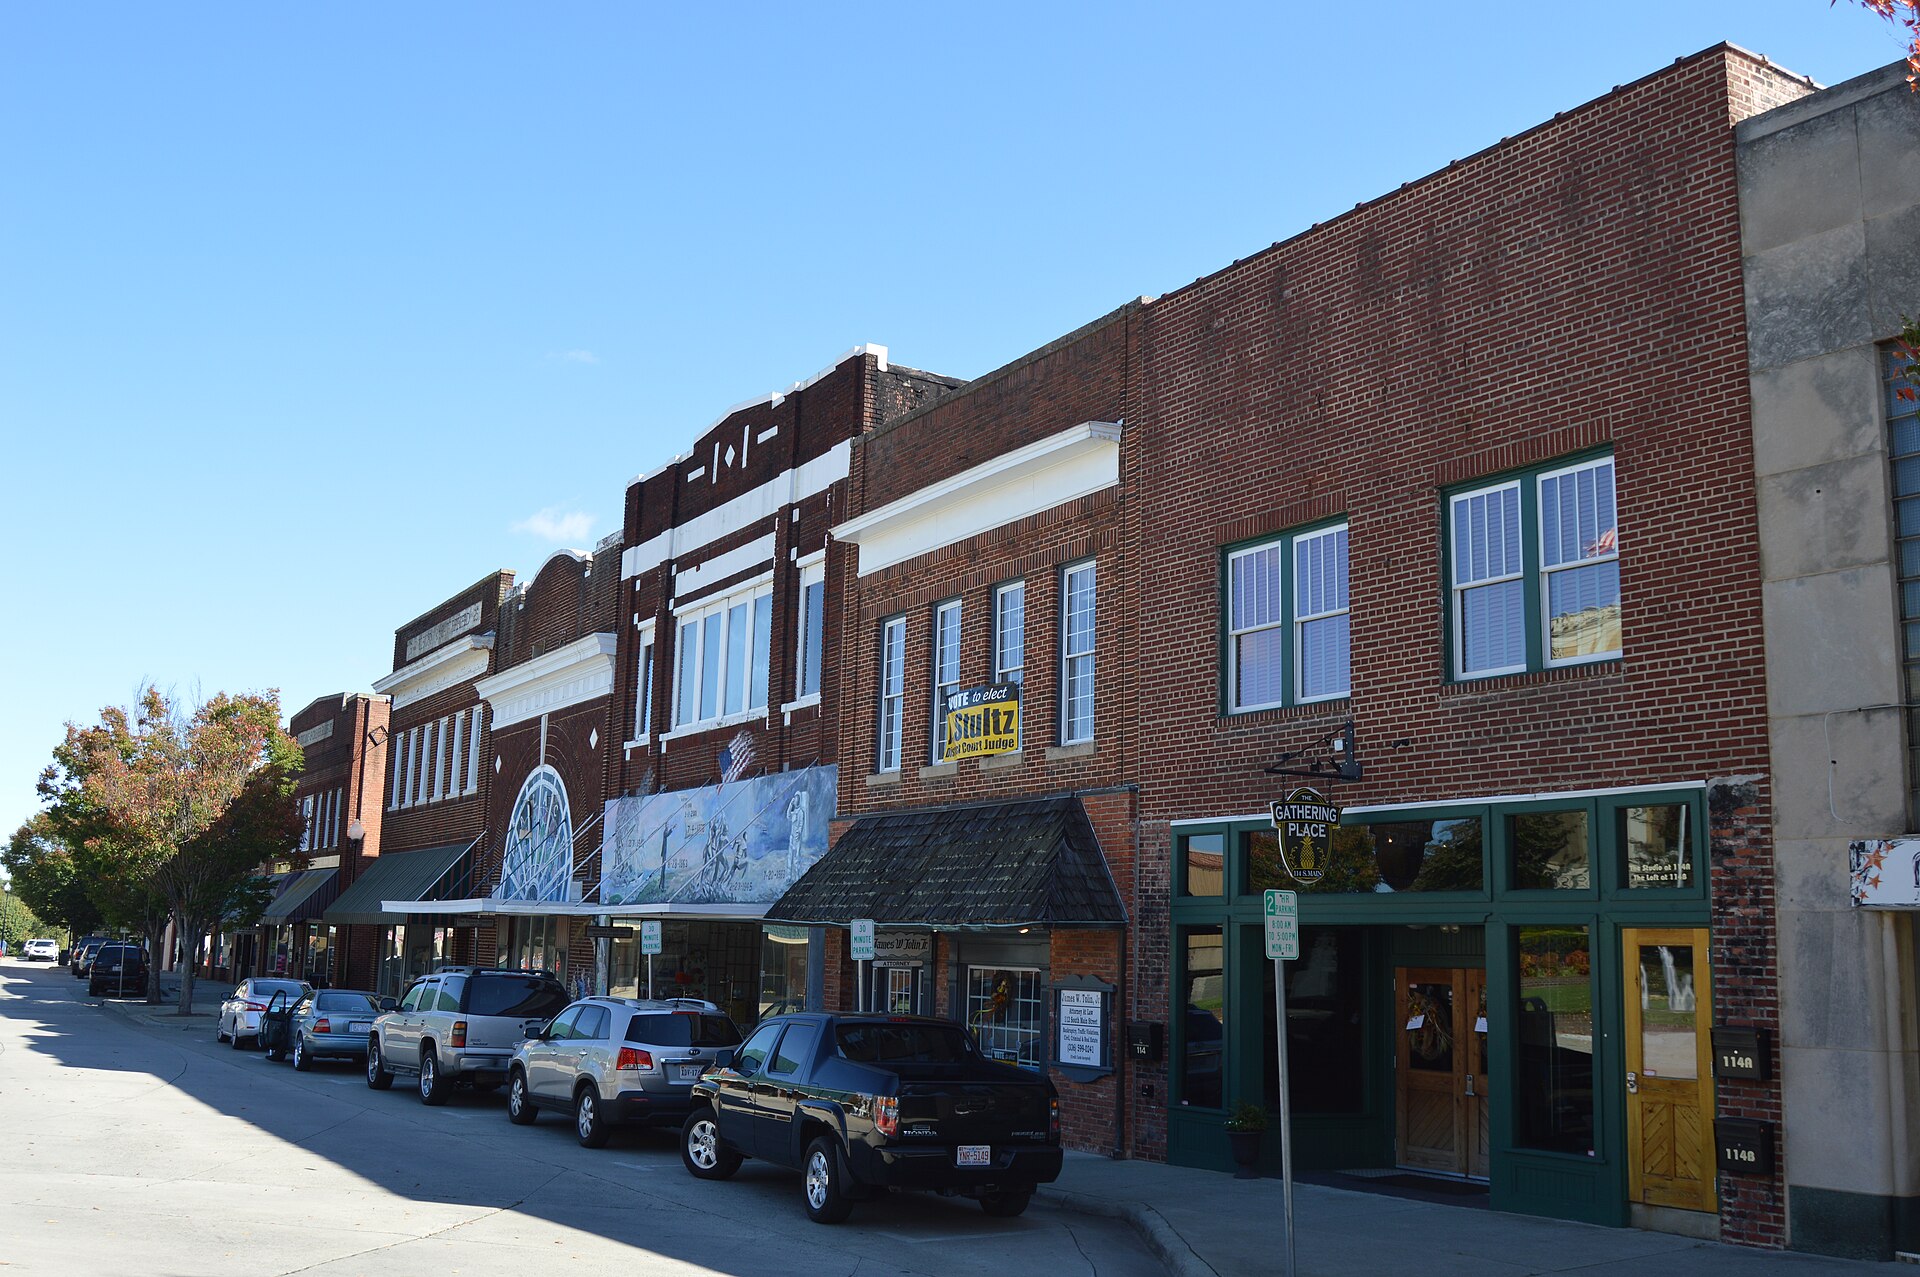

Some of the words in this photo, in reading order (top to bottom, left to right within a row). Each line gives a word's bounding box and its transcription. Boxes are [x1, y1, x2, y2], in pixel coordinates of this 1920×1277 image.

[948, 692, 969, 709] VOTE
[972, 691, 981, 702] to
[983, 687, 1007, 700] elect
[955, 708, 1014, 741] Stultz
[962, 742, 982, 753] Court
[984, 738, 1014, 751] Judge
[1275, 805, 1337, 822] GATHERING
[1288, 823, 1326, 838] PLACE
[1267, 896, 1275, 911] 2
[1281, 895, 1290, 903] HR
[1276, 904, 1296, 914] PARKING
[859, 924, 866, 932] 30
[1272, 920, 1283, 929] 8:00
[854, 936, 871, 944] MINUTE
[1269, 932, 1275, 940] TO
[1277, 931, 1288, 941] 5:00
[1288, 932, 1295, 941] PM
[896, 939, 903, 949] W
[1062, 993, 1075, 1002] James
[1076, 994, 1081, 1003] W.
[994, 1051, 1004, 1059] VOTE
[1723, 1056, 1753, 1069] 114A
[1725, 1148, 1756, 1162] 114B
